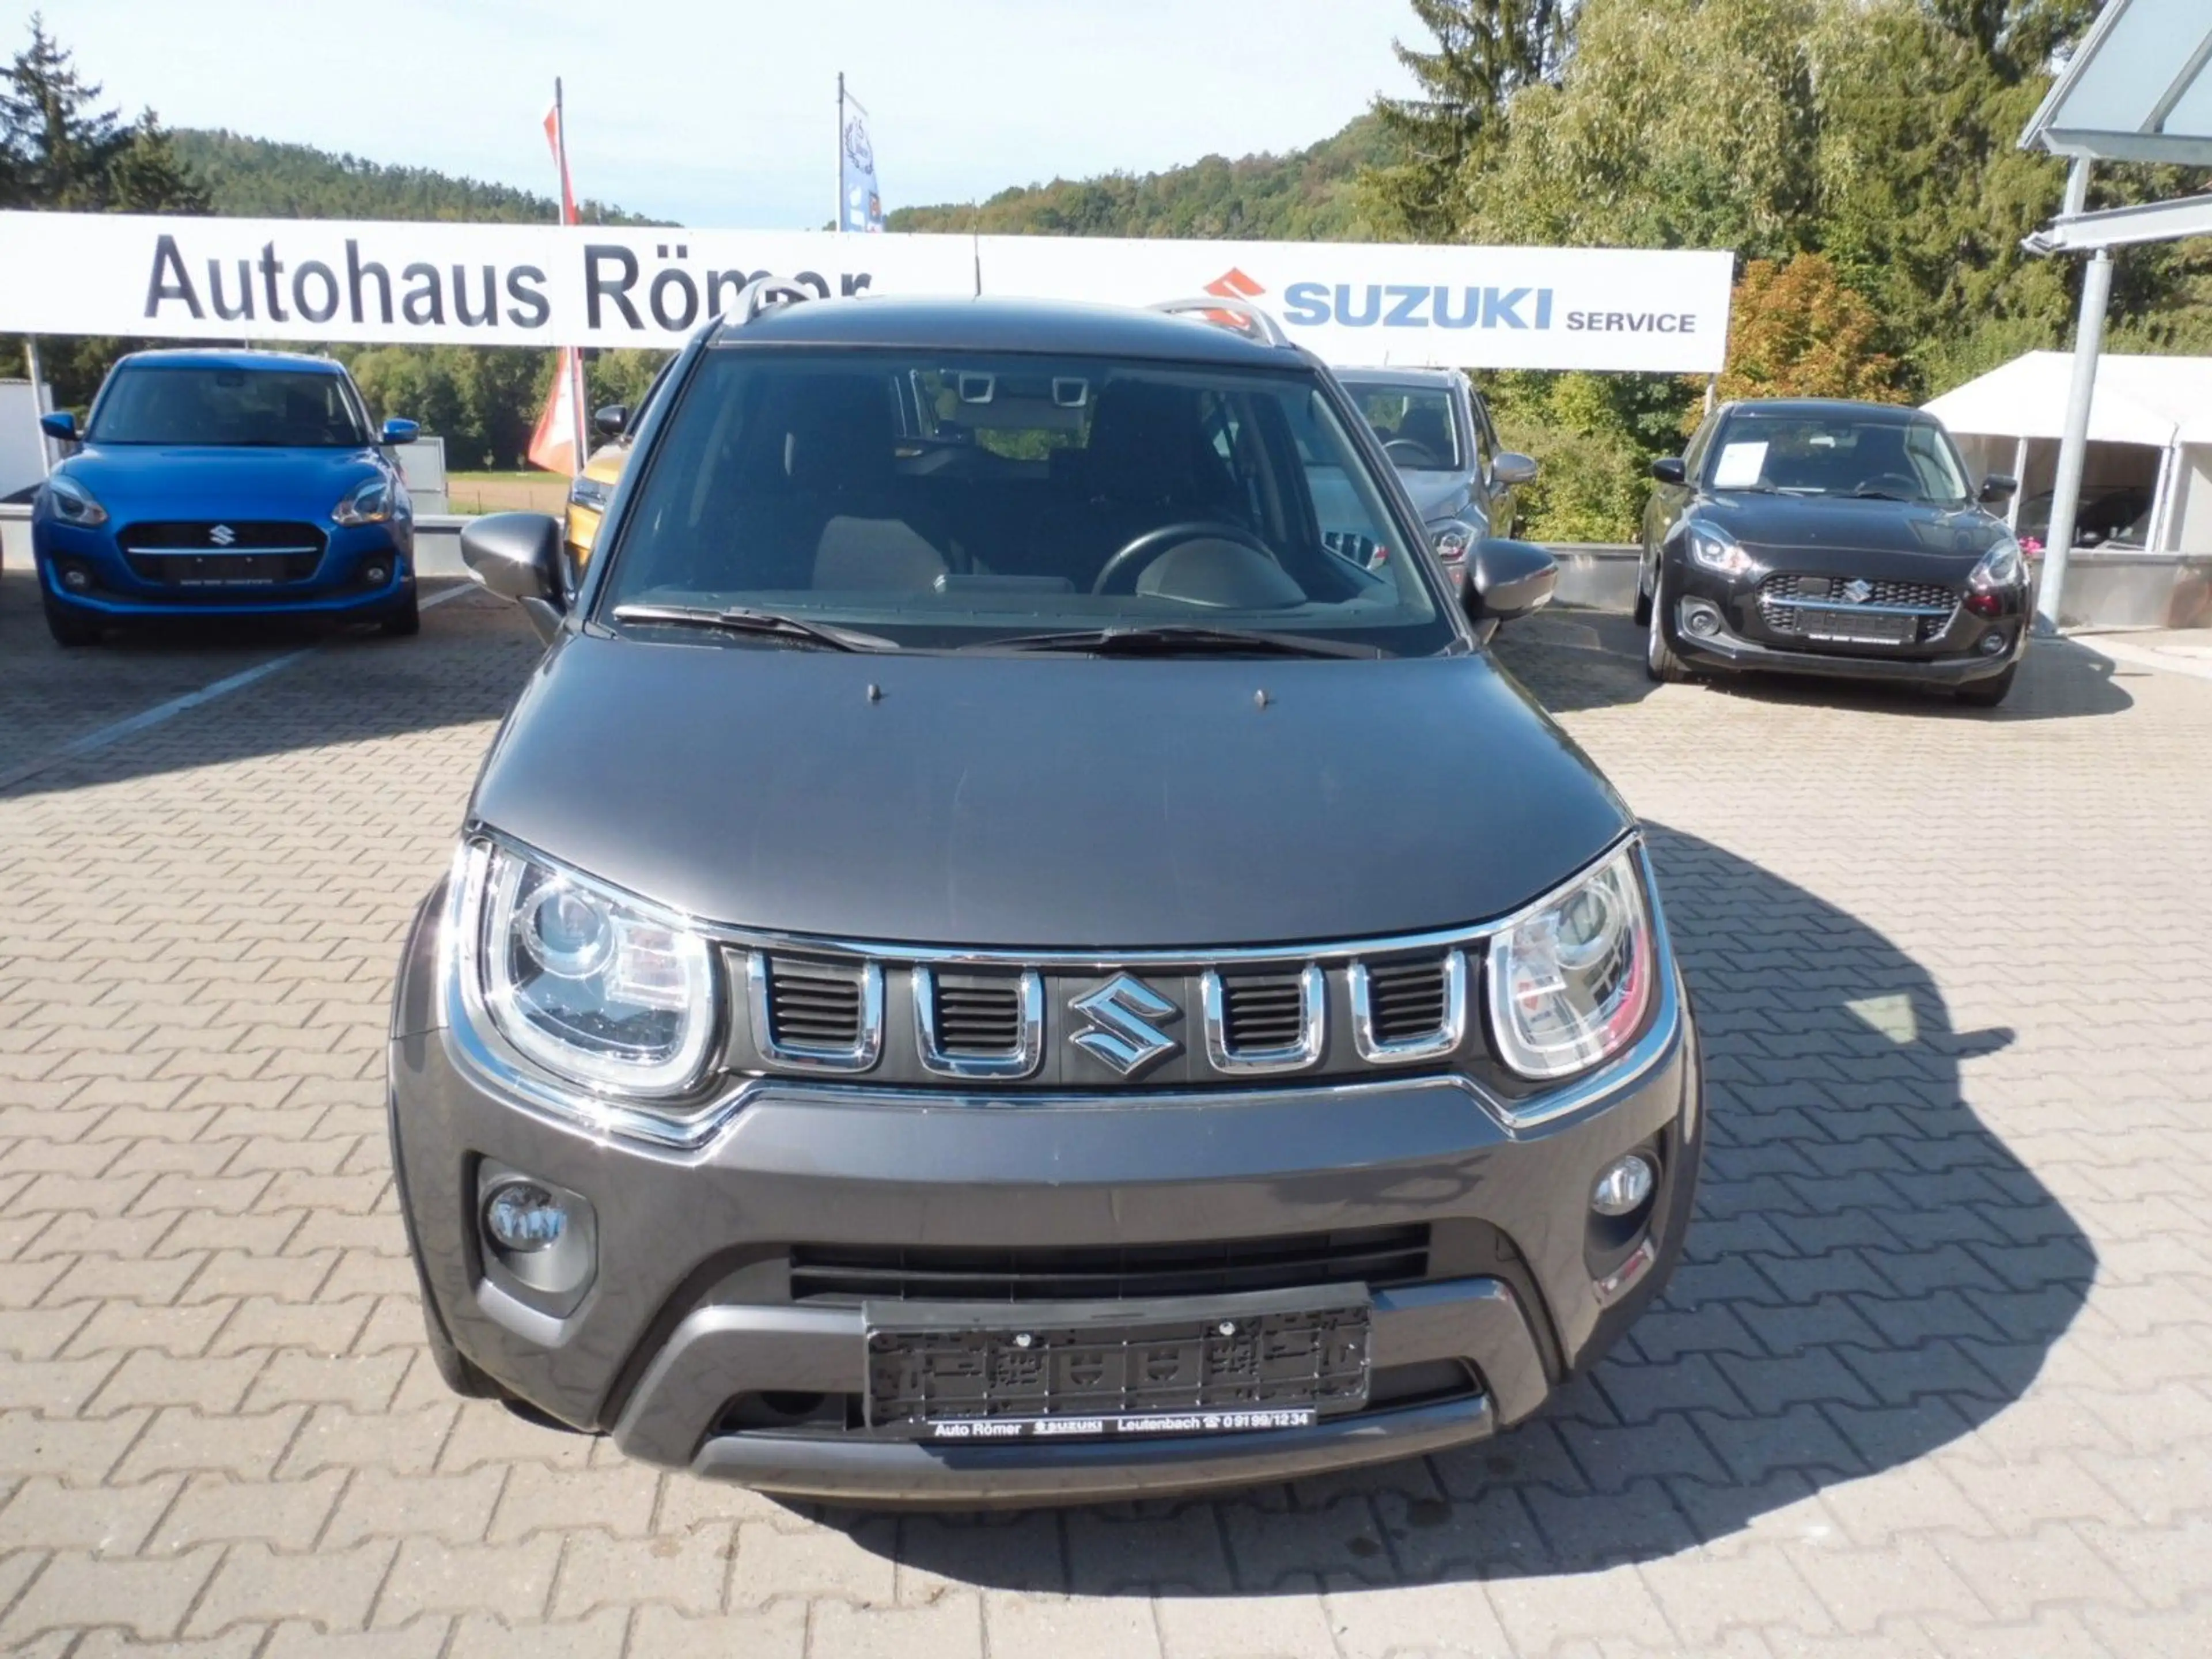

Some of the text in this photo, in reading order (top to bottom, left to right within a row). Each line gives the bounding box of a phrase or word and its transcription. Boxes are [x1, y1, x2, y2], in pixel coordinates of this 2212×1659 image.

[145, 234, 551, 329] Autohaus
[1283, 282, 1696, 333] SUZUKI SERVICE
[934, 1422, 969, 1437] Auto
[972, 1421, 1021, 1436] Römer
[1118, 1416, 1200, 1432] Leutenbach
